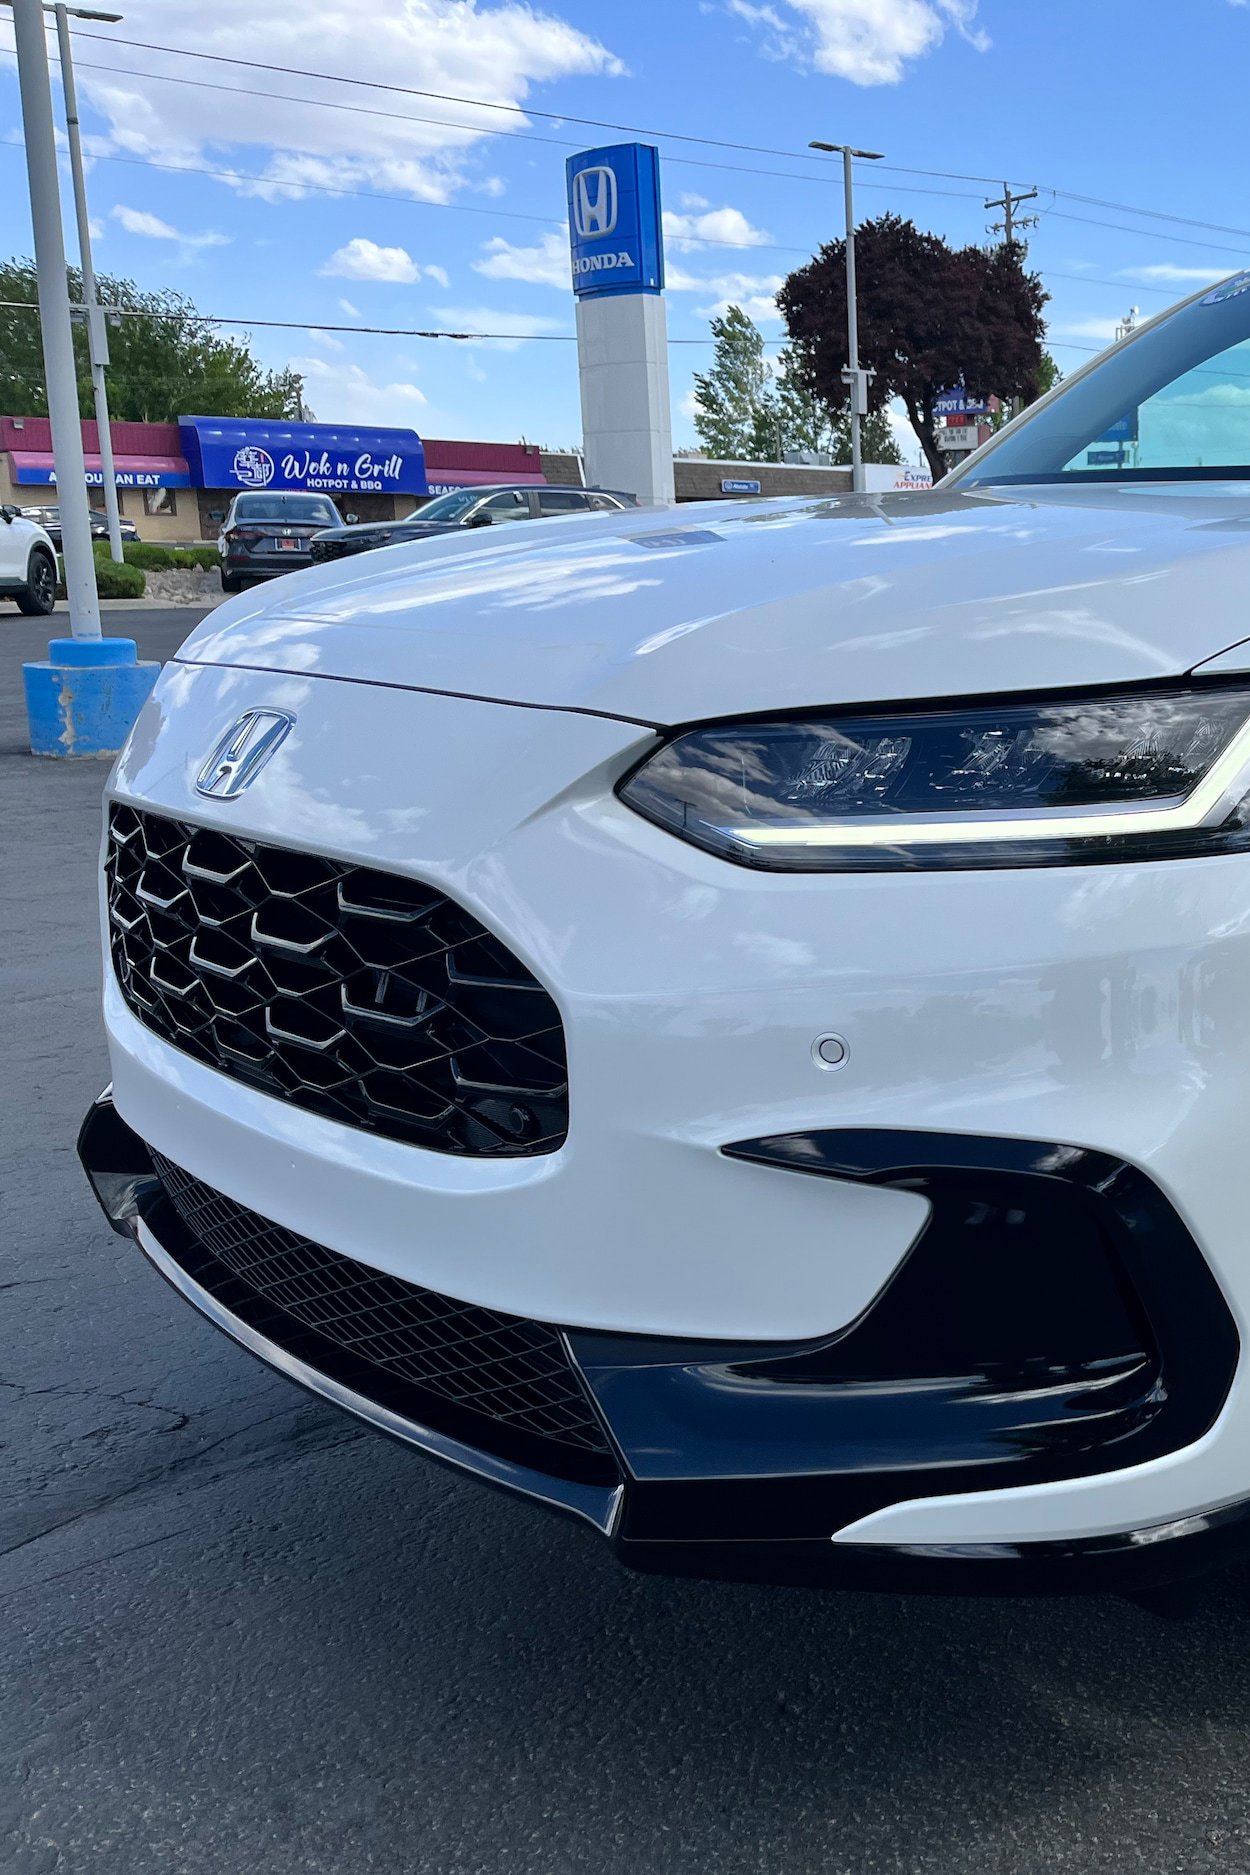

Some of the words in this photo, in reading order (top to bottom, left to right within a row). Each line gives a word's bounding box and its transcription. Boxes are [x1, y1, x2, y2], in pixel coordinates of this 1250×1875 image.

[573, 251, 635, 275] HONDA
[933, 400, 957, 412] TPOT
[281, 451, 333, 479] Wok
[336, 461, 350, 476] n
[354, 453, 403, 480] Grill
[84, 473, 102, 483] OU
[116, 474, 133, 484] AN
[137, 474, 160, 485] EAT
[904, 471, 932, 482] EXPRE
[307, 478, 349, 489] HOTPOT
[351, 479, 359, 489] &
[360, 480, 382, 490] BBQ
[428, 484, 460, 495] SEAF
[894, 481, 932, 490] APPLIAN
